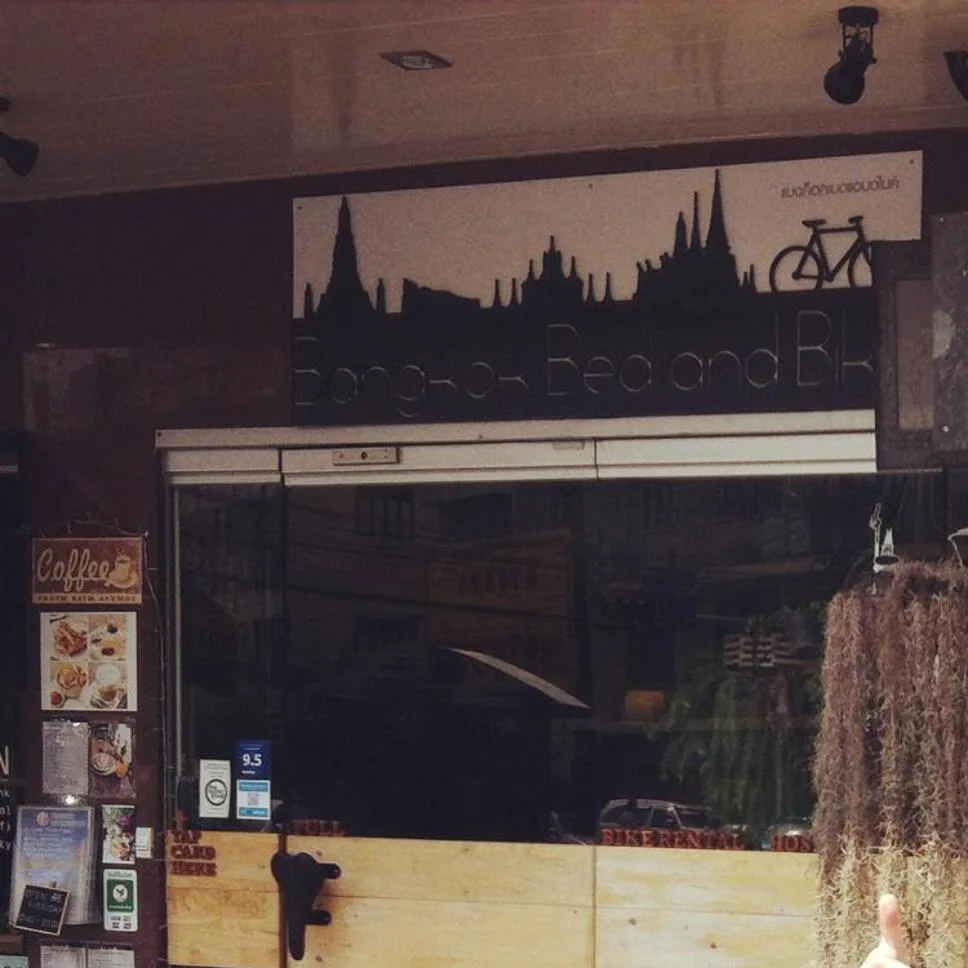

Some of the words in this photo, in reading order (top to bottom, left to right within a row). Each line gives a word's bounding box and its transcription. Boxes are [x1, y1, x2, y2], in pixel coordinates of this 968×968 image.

[37, 547, 110, 592] Coffee
[242, 753, 262, 767] 9.5
[601, 827, 653, 848] BIKE
[658, 829, 745, 851] RENTAL
